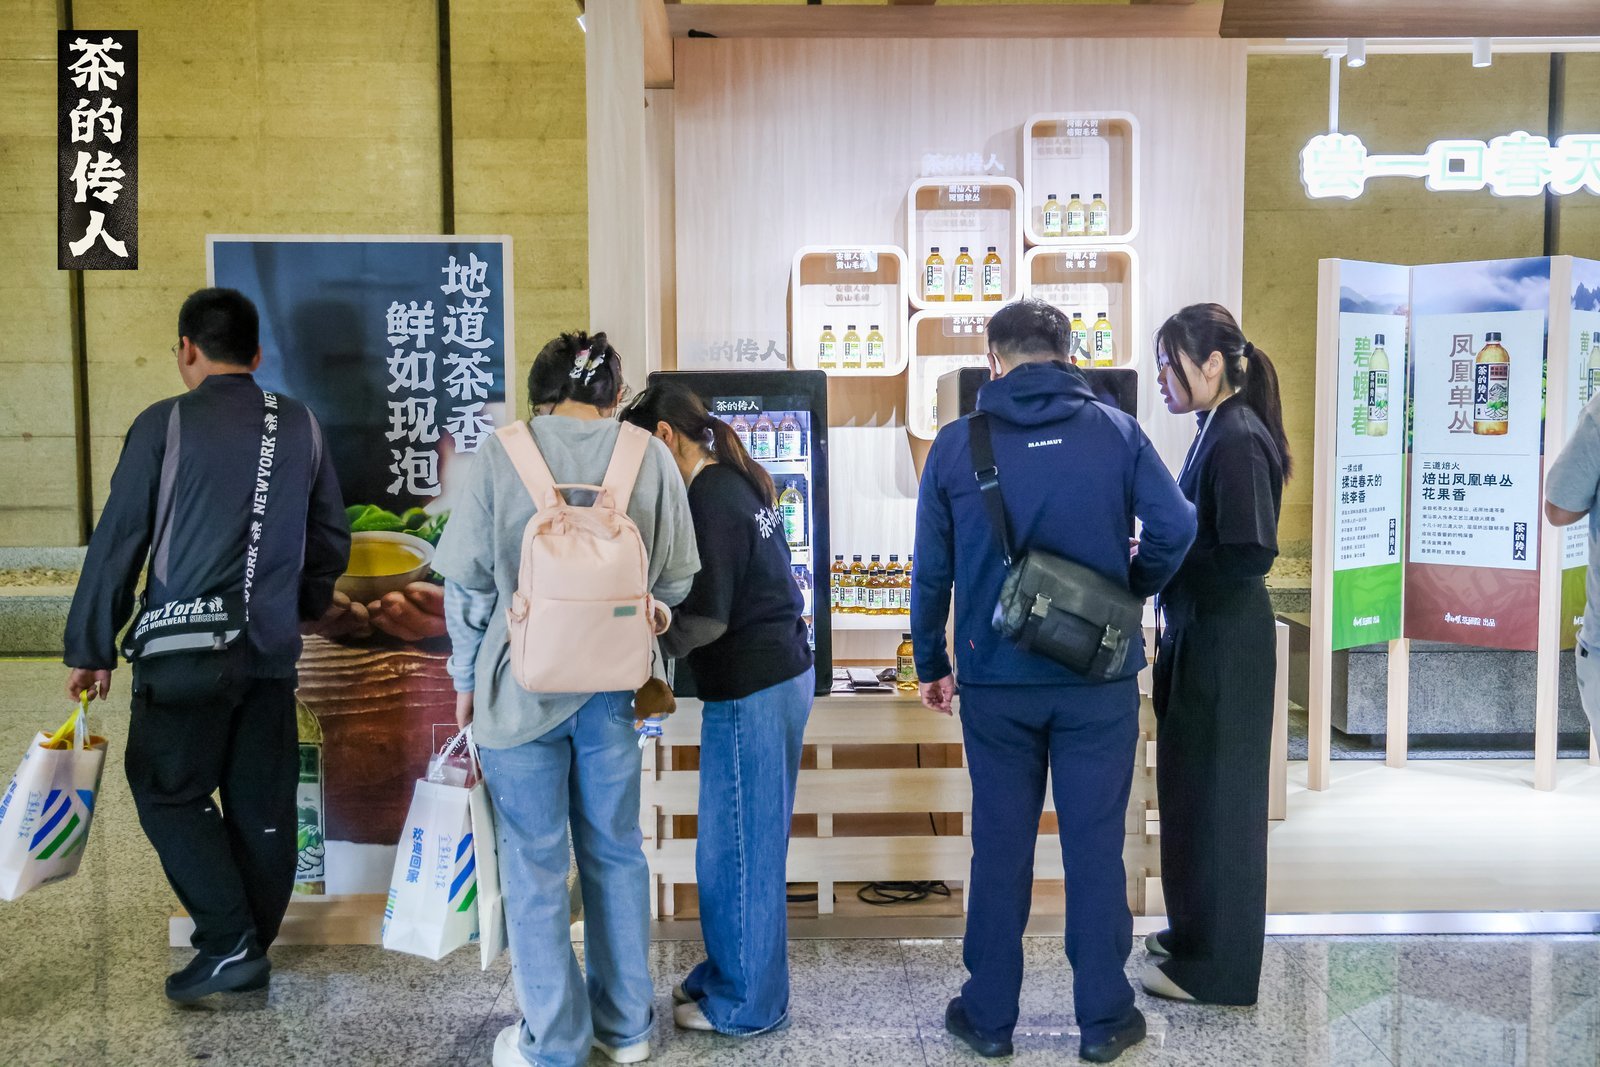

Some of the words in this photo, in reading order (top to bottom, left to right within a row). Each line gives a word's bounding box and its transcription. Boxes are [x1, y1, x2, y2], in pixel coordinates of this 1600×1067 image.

[1304, 133, 1600, 197] 尝一口春天
[441, 252, 495, 454] 地道茶香
[385, 300, 441, 497] 鲜如现泡
[1352, 336, 1371, 436] 碧螺春
[1448, 334, 1476, 434] 凤凰单丛
[716, 400, 759, 412] 茶的传人
[1028, 439, 1062, 448] MAMMUT
[253, 434, 277, 516] NEWYORK
[1341, 474, 1382, 489] 揉进春天的
[1422, 472, 1513, 487] 焙出凤凰单丛
[1423, 461, 1460, 470] 三道焙火
[1422, 487, 1466, 501] 花果香
[1514, 523, 1525, 559] 茶的传人
[136, 598, 206, 631] ewYork
[150, 615, 187, 630] WORKWEAR
